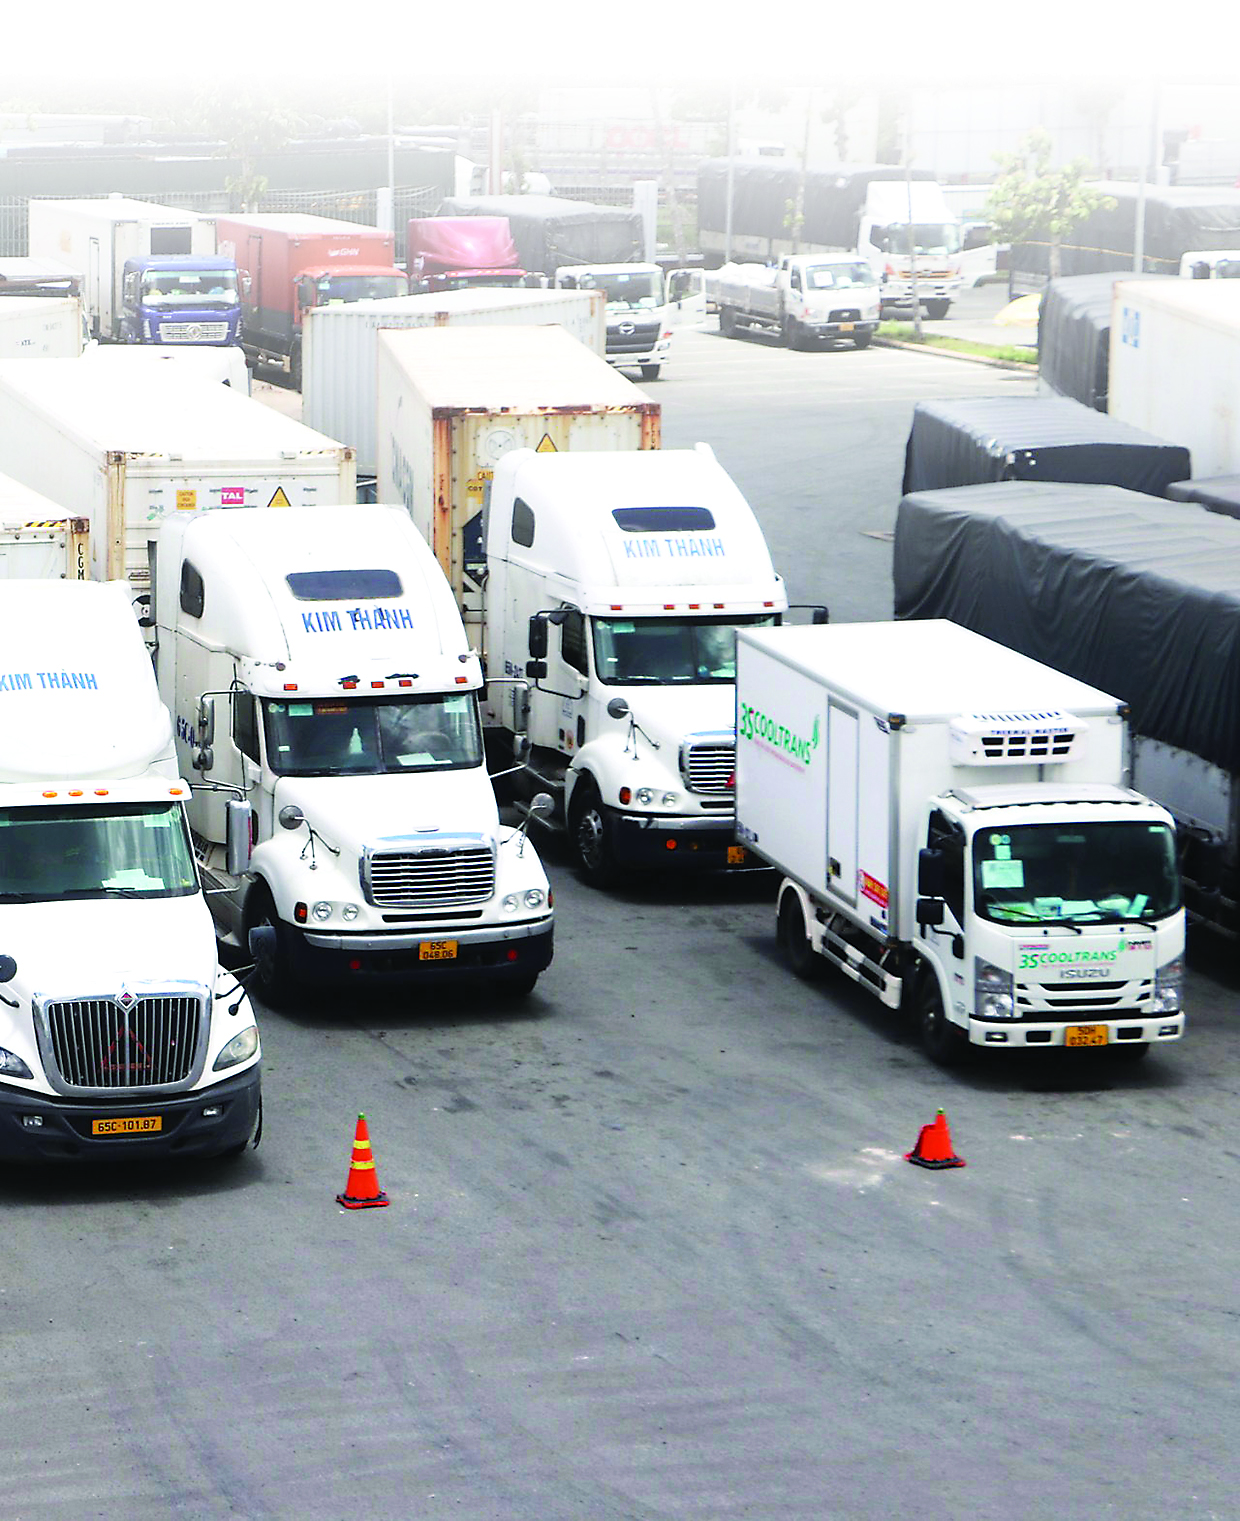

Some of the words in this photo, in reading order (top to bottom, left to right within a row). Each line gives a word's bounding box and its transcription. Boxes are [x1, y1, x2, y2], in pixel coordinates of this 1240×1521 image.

[623, 539, 661, 558] KIM
[301, 611, 342, 633] KIM
[1060, 968, 1110, 979] ISUZU
[98, 1119, 157, 1132] 65C-101.87
